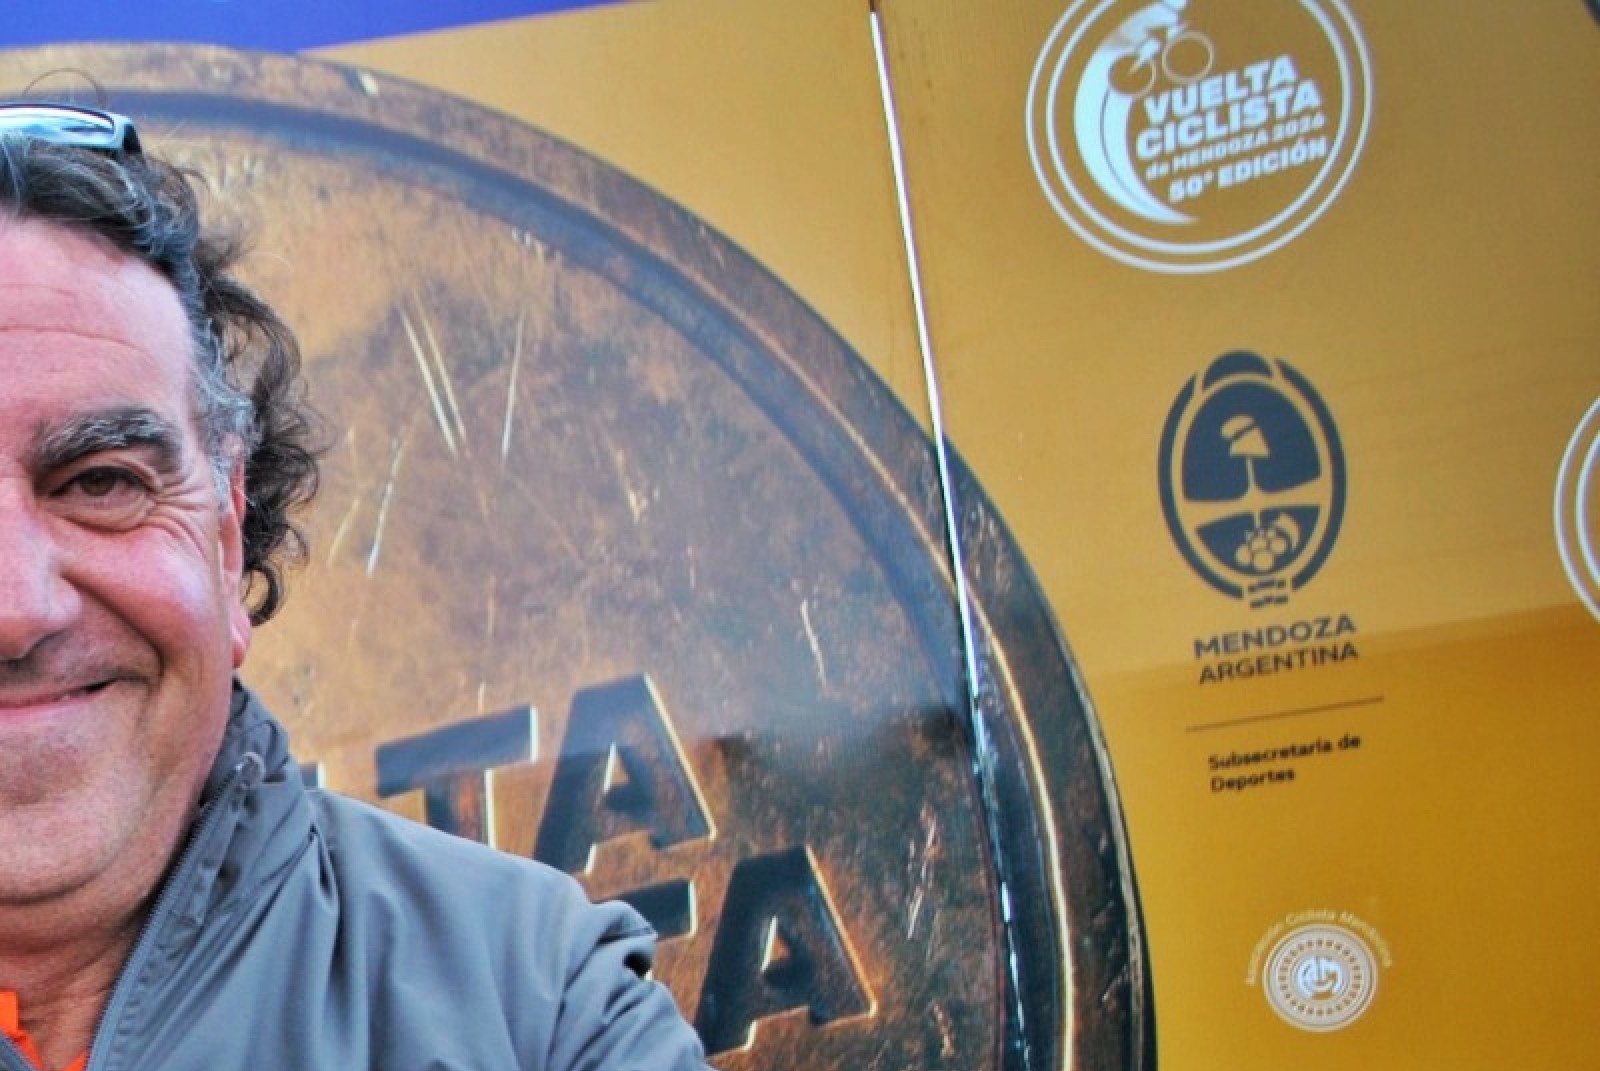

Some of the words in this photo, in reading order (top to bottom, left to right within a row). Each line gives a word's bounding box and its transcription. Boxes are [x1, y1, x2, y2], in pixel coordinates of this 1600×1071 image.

[1143, 54, 1298, 126] VUELTA
[1135, 78, 1322, 160] CICLISTA
[1173, 128, 1269, 174] MENDOZA
[1217, 135, 1327, 189] EDICIÓN
[1193, 613, 1357, 660] MENDOZA
[1199, 642, 1359, 685] ARGENTINA
[1338, 731, 1361, 750] de
[1211, 769, 1295, 792] Deportes
